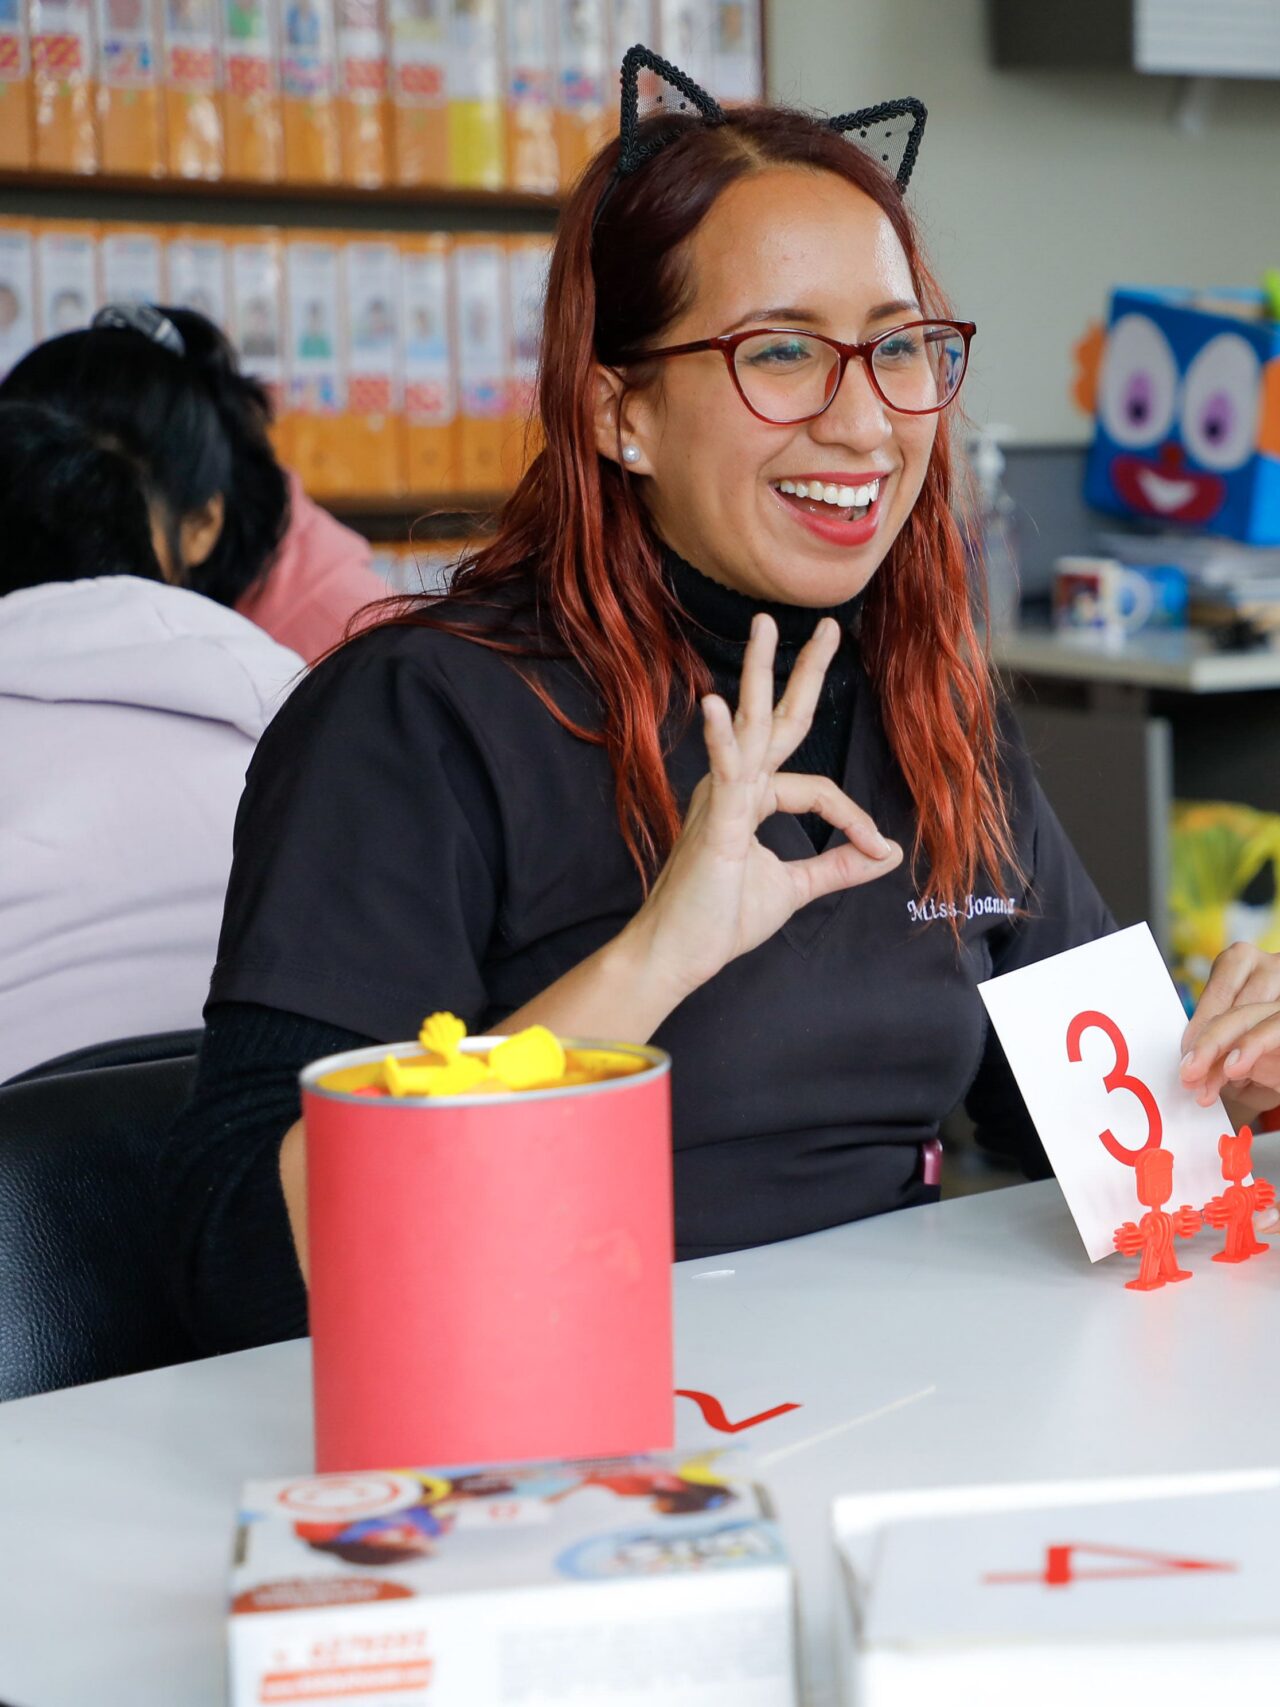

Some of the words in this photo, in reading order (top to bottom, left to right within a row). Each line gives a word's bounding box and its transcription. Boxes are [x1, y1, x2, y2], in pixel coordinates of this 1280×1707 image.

[907, 898, 958, 922] Miss
[1066, 1010, 1163, 1168] 3
[980, 1542, 1240, 1588] 4
